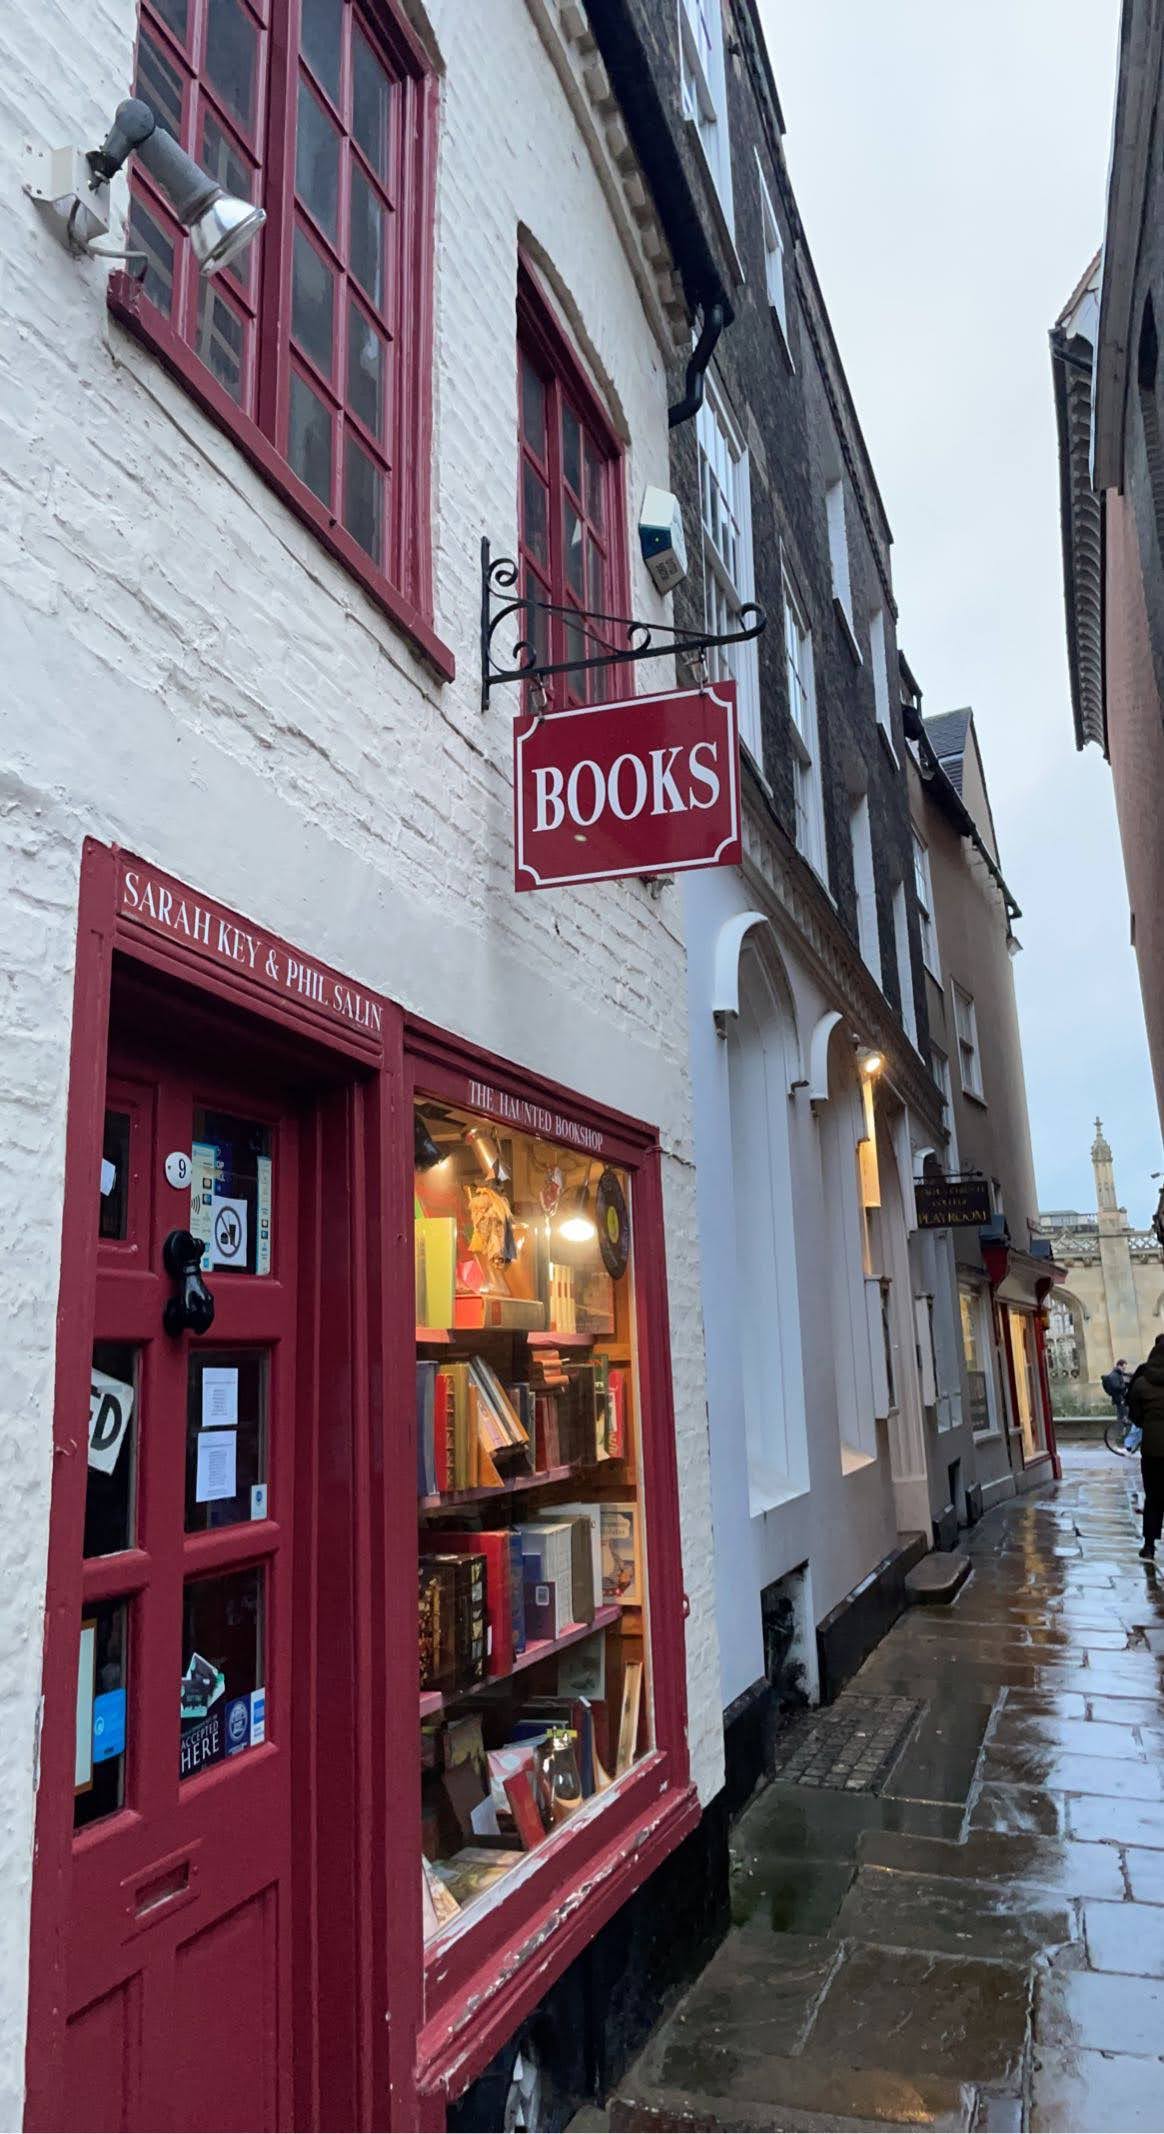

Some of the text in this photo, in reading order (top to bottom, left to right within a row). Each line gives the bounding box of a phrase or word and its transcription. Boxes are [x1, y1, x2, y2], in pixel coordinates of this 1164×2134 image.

[531, 741, 721, 833] BOOKS
[123, 871, 384, 1032] SARAH KEY & PHIL SALIN
[469, 1080, 603, 1152] THE HAUNTED BOOKSHOP
[178, 1158, 187, 1179] 9
[181, 1720, 219, 1750] ACCEPTED
[181, 1731, 220, 1773] HERE
